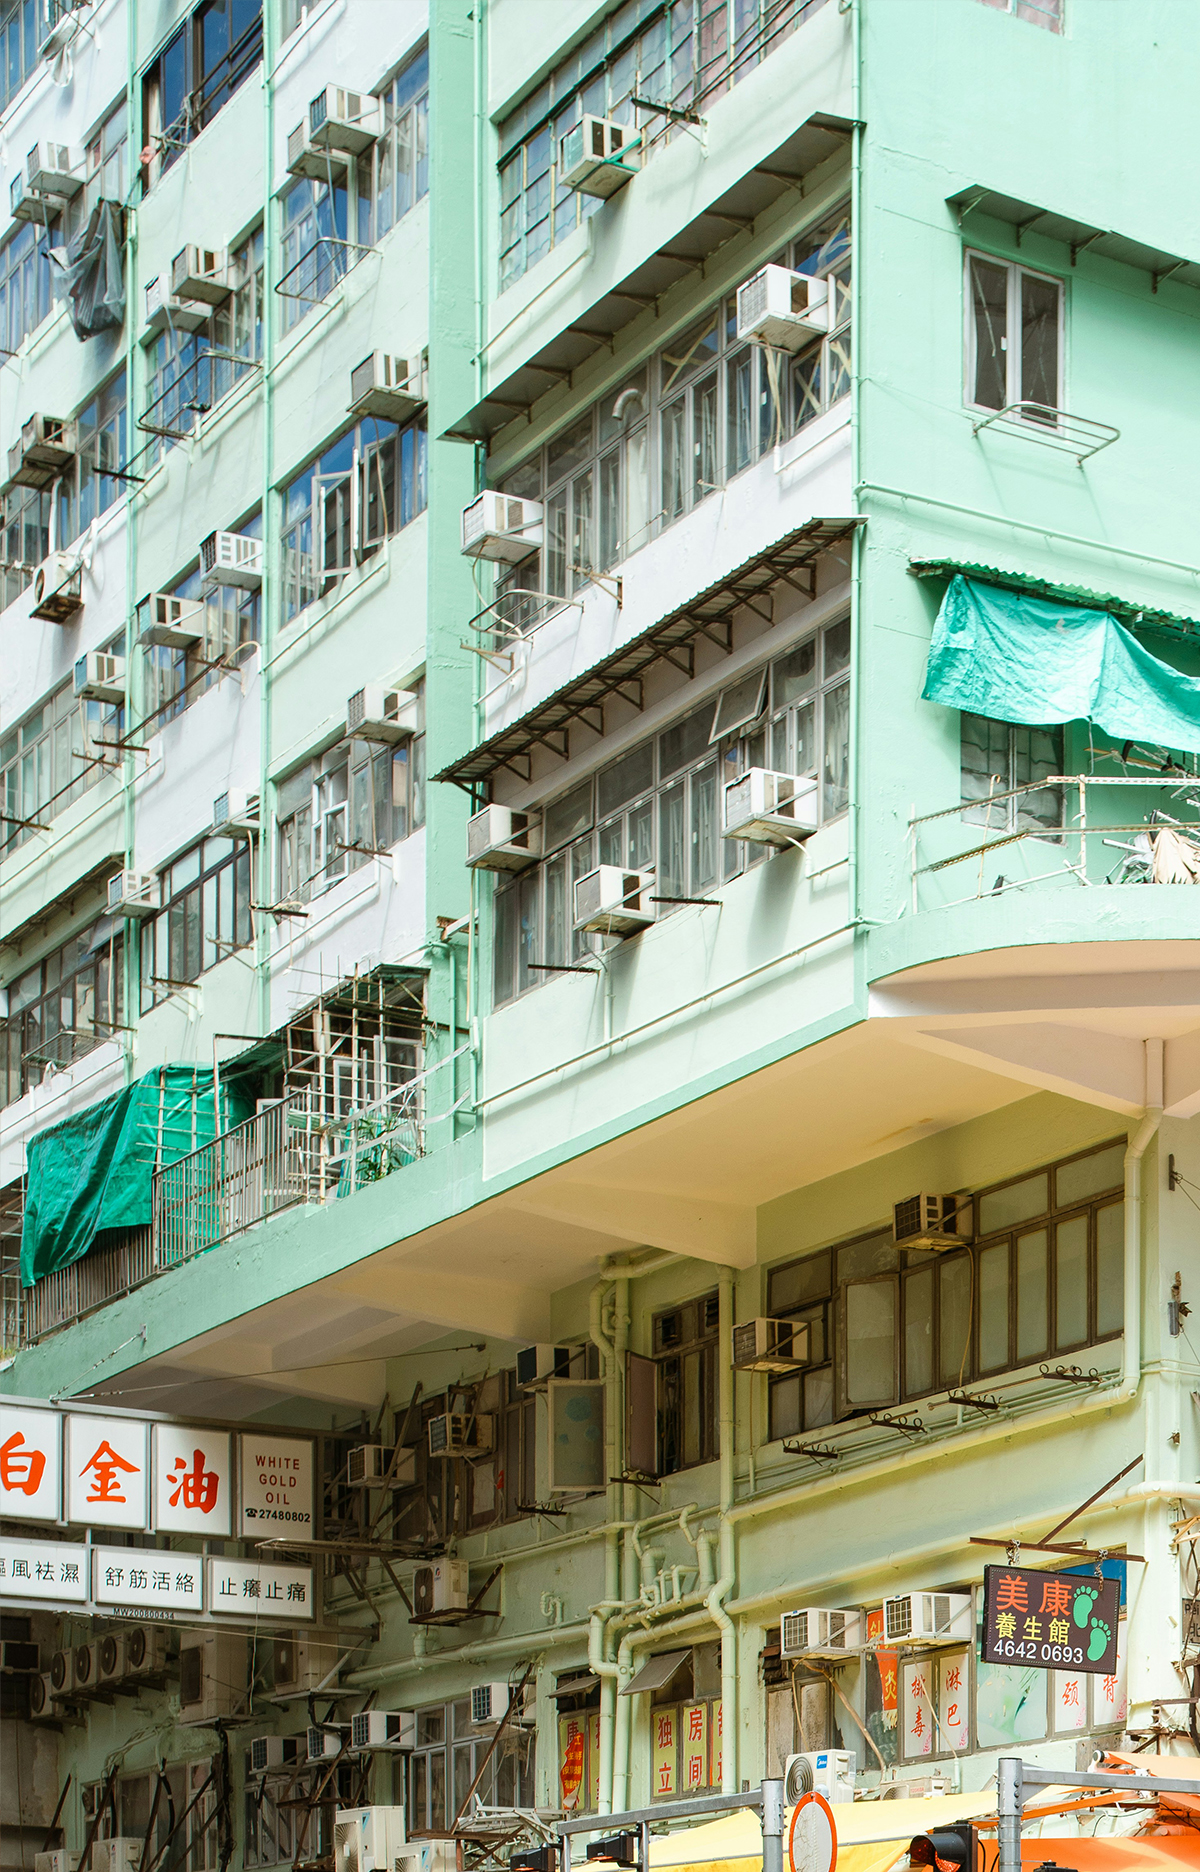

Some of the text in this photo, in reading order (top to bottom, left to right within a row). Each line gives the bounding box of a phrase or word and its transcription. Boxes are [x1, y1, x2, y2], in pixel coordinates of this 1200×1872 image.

[0, 1432, 220, 1514] 白金油
[255, 1455, 301, 1471] WHITE
[258, 1473, 297, 1489] GOLD
[265, 1492, 290, 1506] OIL
[258, 1509, 311, 1524] 27480802
[105, 1566, 195, 1594] 舒筋活絡
[219, 1576, 306, 1603] 止癢止痛
[995, 1575, 1072, 1617] 美康
[113, 1608, 175, 1620] MW200800434
[995, 1612, 1071, 1646] 養生館
[993, 1640, 1084, 1664] 4642 0693
[910, 1672, 928, 1738] 排毒
[945, 1666, 962, 1727] 淋巴
[657, 1714, 674, 1794] 独立
[688, 1707, 704, 1788] 房间
